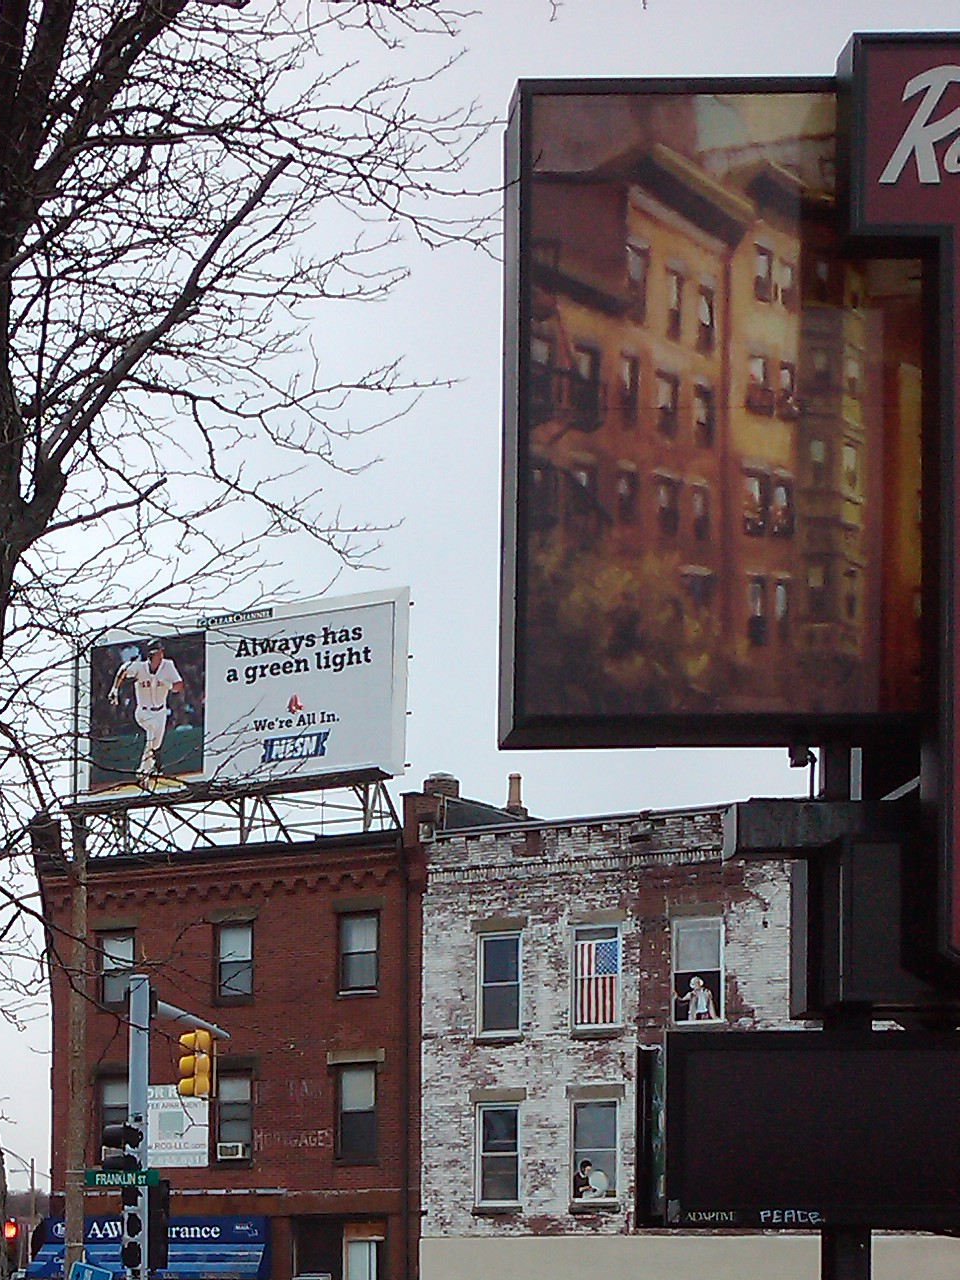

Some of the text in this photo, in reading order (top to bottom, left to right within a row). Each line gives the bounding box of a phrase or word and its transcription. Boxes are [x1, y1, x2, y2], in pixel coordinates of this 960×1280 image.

[235, 626, 363, 658] Always has
[226, 646, 372, 684] a green light
[253, 711, 340, 732] We're All In.
[95, 1173, 147, 1185] FRANKLIN ST
